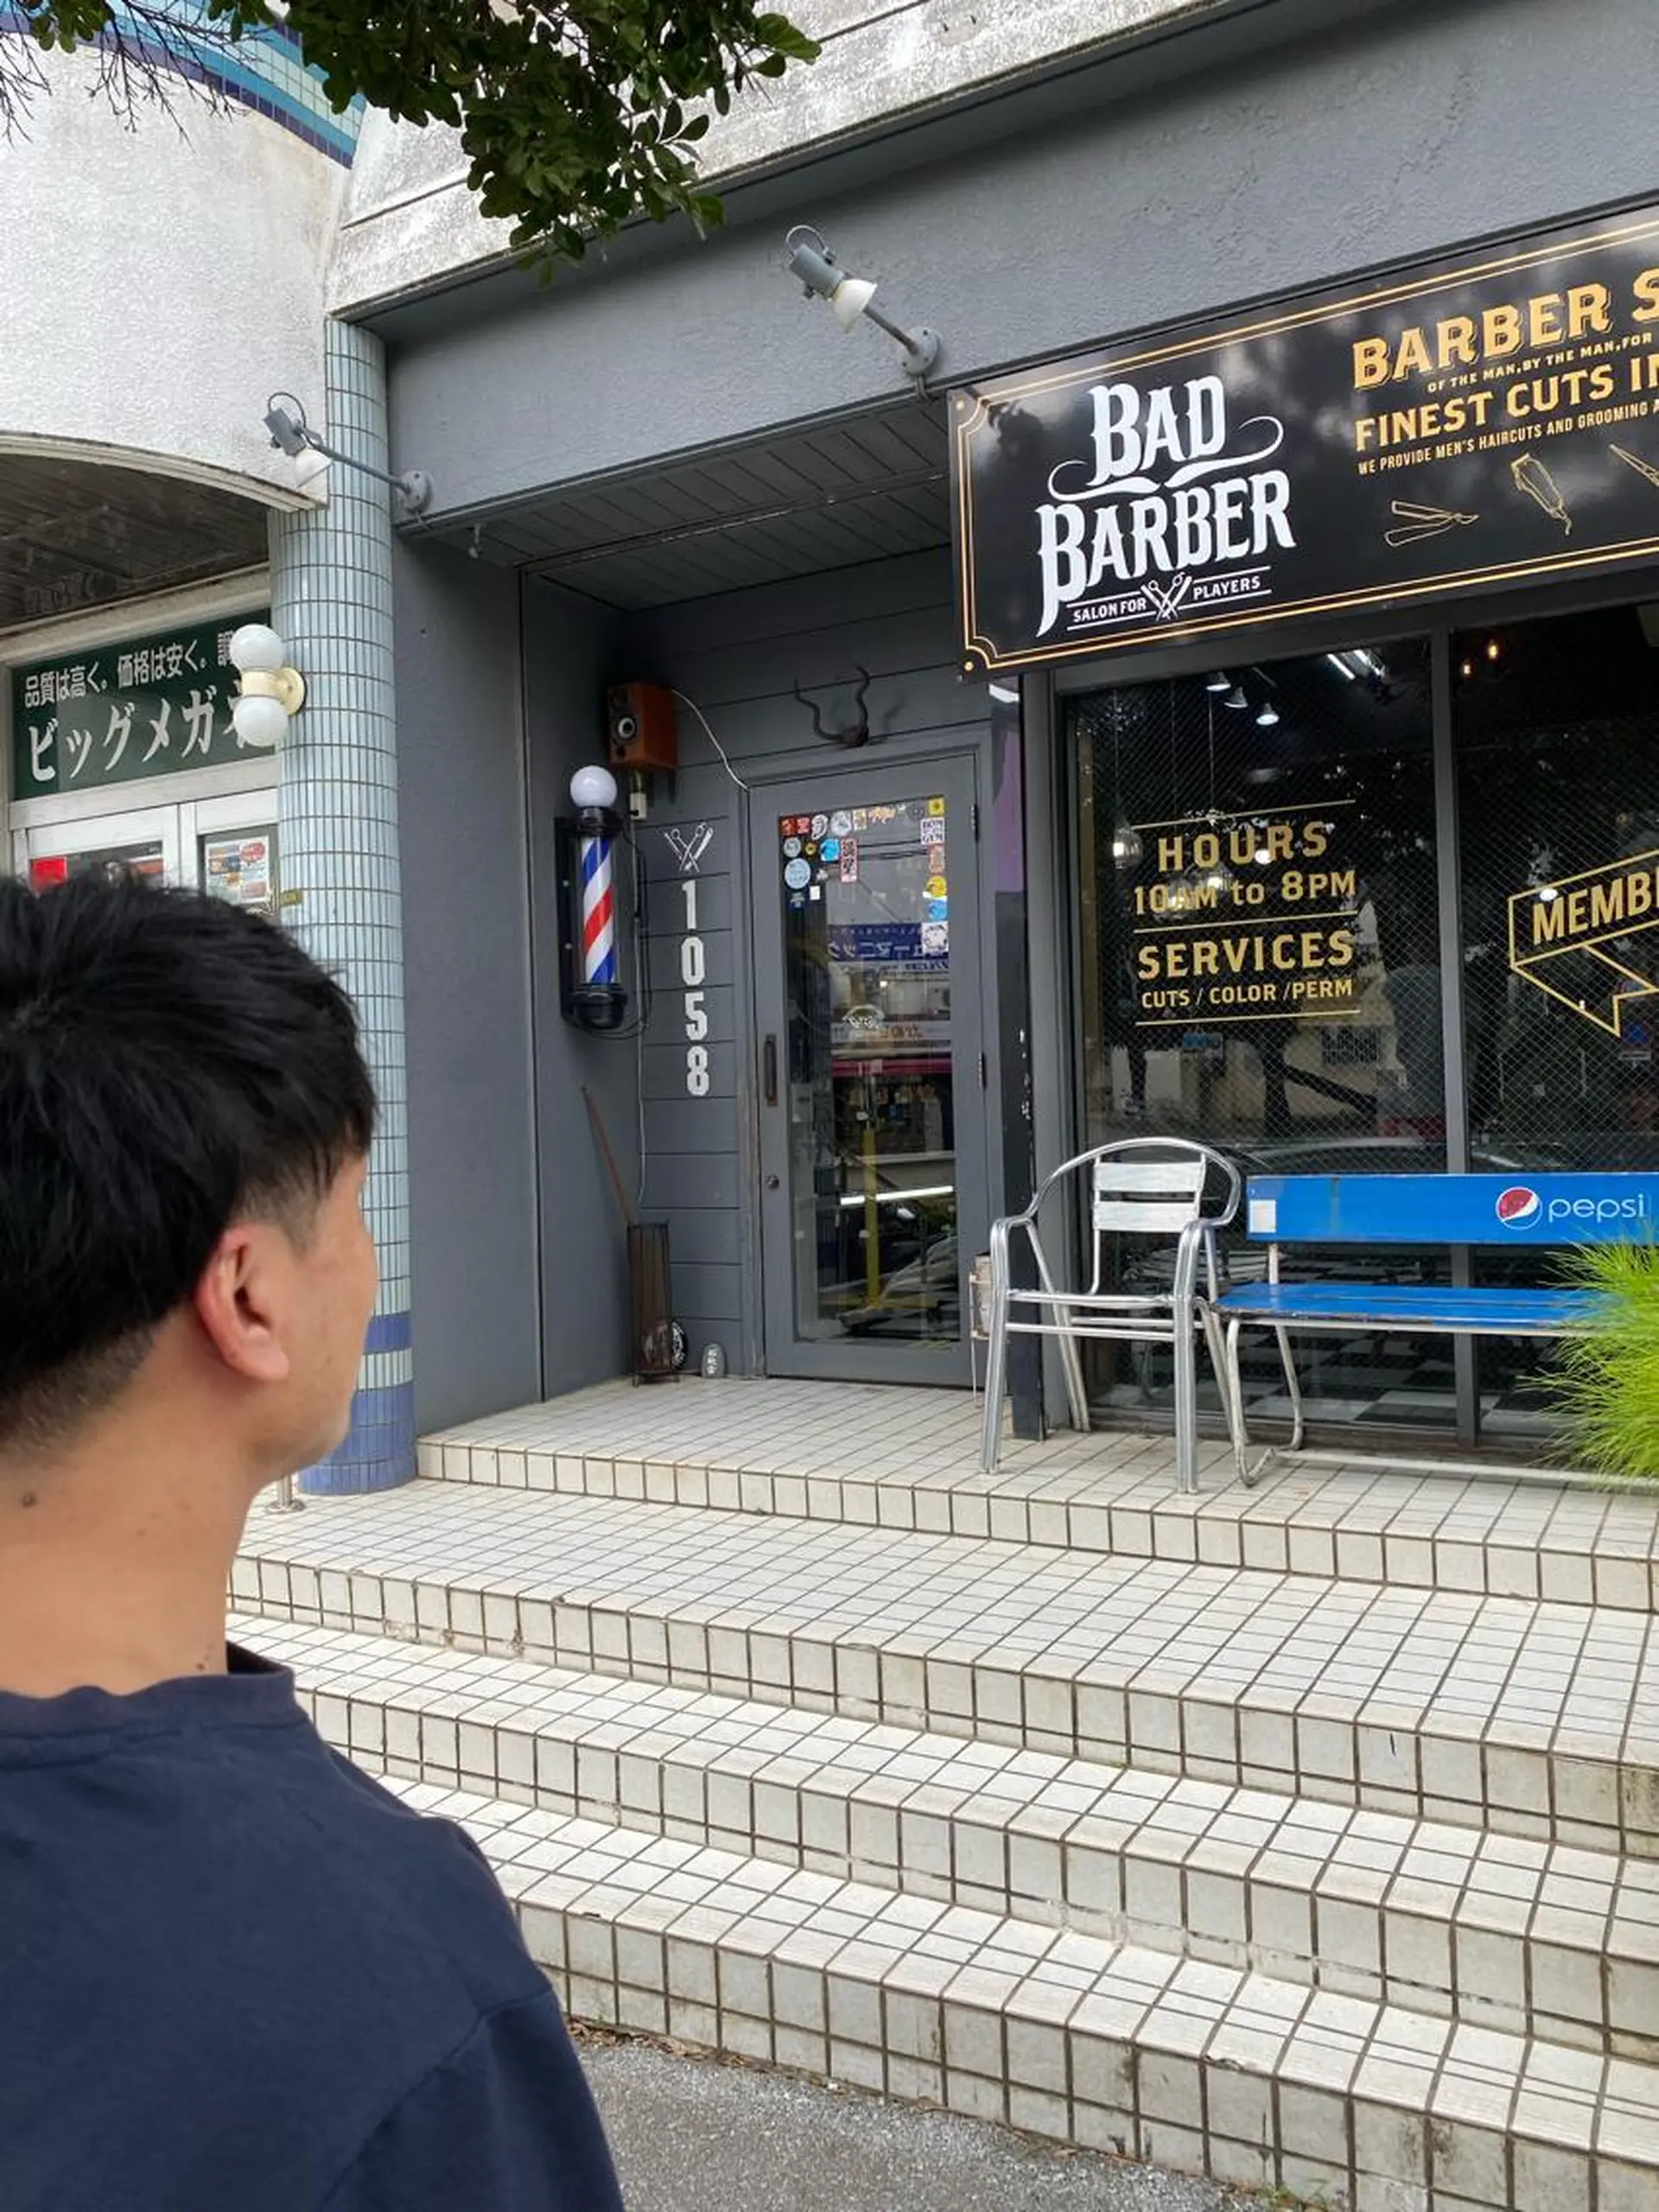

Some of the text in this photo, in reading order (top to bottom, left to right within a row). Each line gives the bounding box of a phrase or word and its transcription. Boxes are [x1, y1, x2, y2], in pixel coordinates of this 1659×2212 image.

[1352, 283, 1613, 391] BARBER
[1427, 379, 1446, 393] OF
[1450, 372, 1478, 387] THE
[1546, 348, 1575, 365] THE
[1086, 375, 1226, 486] BAD
[1354, 391, 1493, 452] FINEST
[1506, 365, 1615, 417] CUTS
[1357, 460, 1376, 475] WE
[1379, 447, 1433, 471] PROVIDE
[1435, 438, 1475, 459] MEN'S
[1478, 423, 1542, 449] HAIRCUTS
[1546, 417, 1573, 435] AND
[1578, 401, 1649, 429] GROOMING
[1035, 469, 1296, 638] BARBER
[1073, 575, 1262, 624] SALON FOR PLAYERS
[1157, 821, 1328, 873] HOURS
[1134, 870, 1357, 915] 10AM to 8PM
[1532, 866, 1659, 945] MEMB
[1137, 930, 1354, 980] SERVICES
[682, 880, 709, 1096] 1058
[1141, 988, 1191, 1009] CUTS
[1210, 983, 1277, 1005] COLOR
[1548, 1193, 1644, 1224] pepsi
